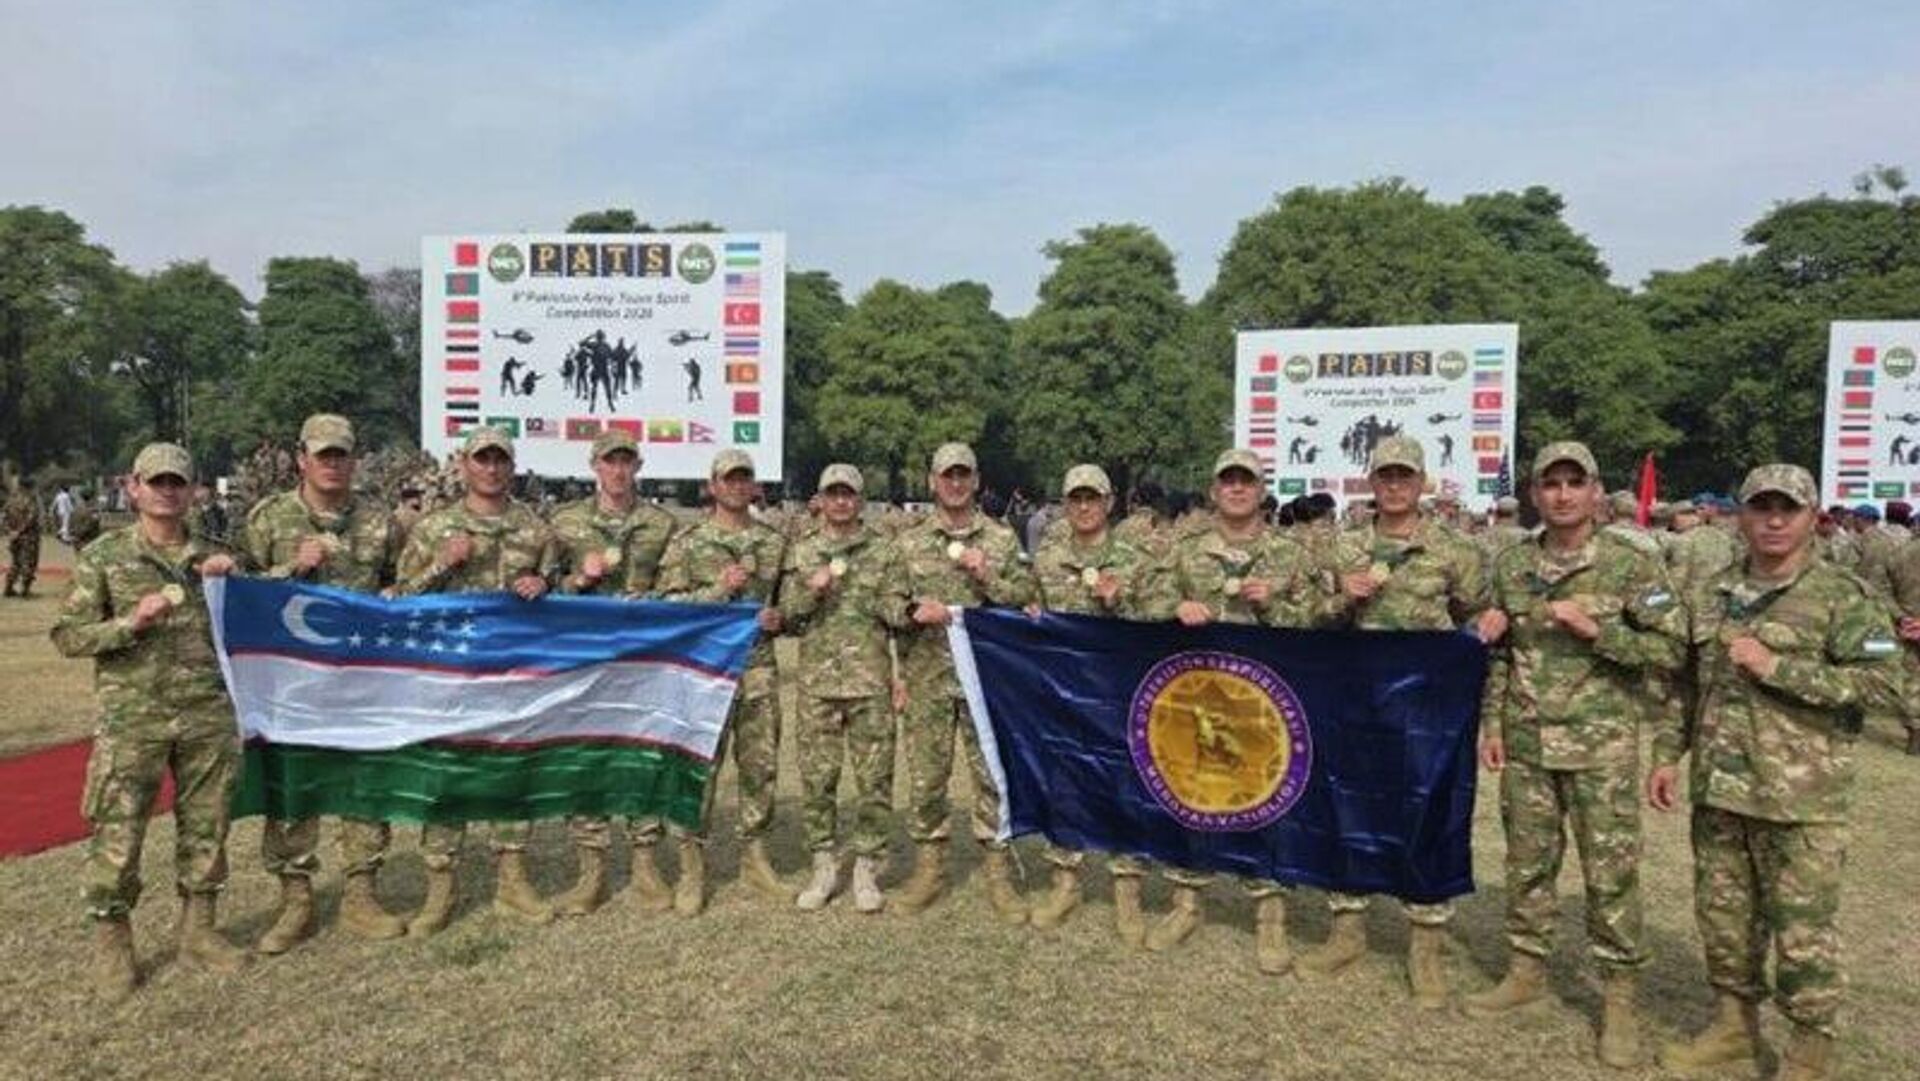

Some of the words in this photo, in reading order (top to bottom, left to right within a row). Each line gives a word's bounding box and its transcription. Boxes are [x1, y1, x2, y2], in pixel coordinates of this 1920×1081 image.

[537, 244, 665, 271] PATS
[582, 291, 614, 305] Army
[545, 306, 621, 320] Competition
[1325, 352, 1427, 374] PATS
